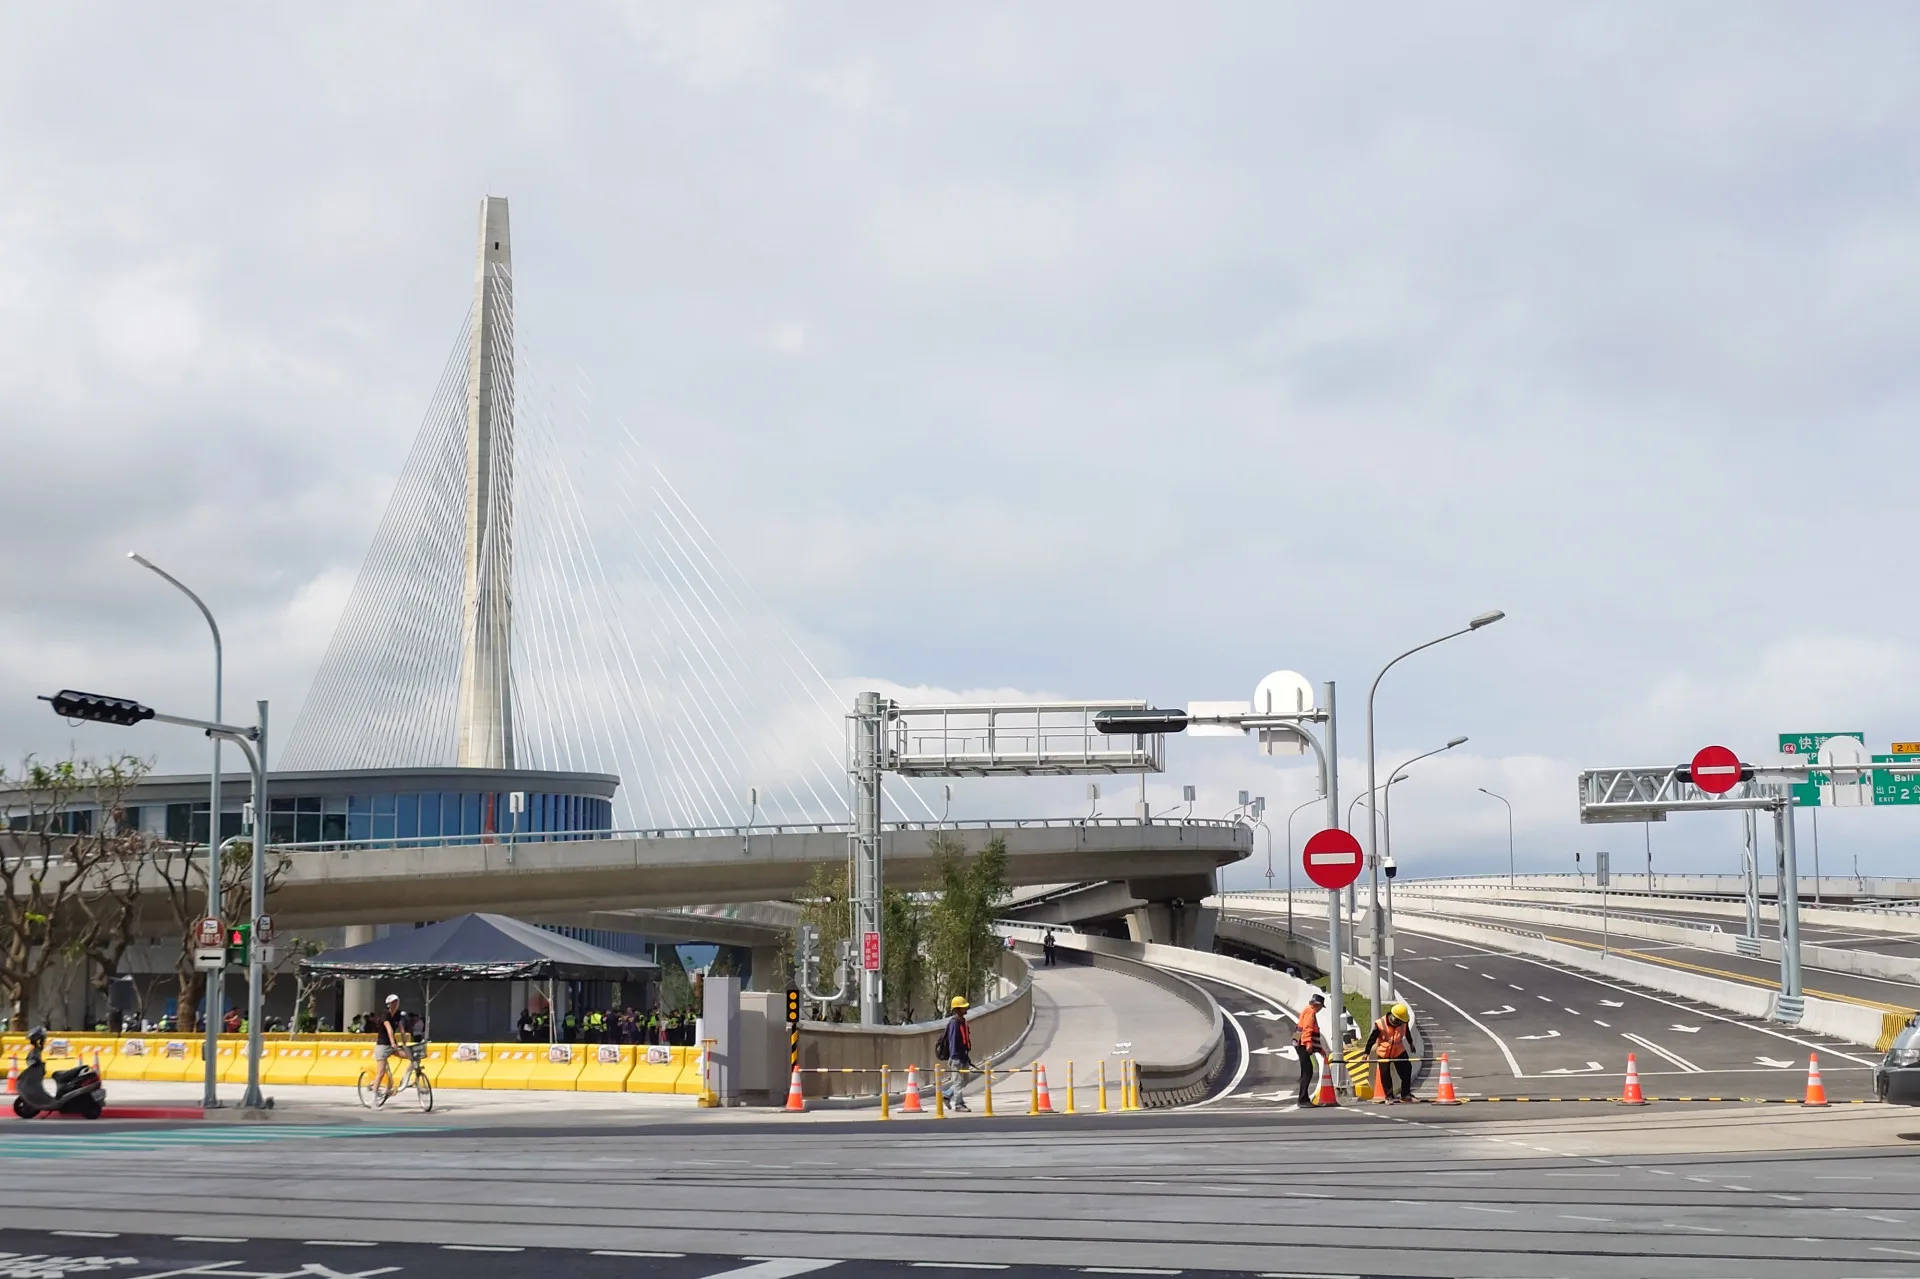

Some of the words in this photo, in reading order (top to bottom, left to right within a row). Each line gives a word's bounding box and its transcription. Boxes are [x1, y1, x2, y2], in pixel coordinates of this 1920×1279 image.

[1785, 744, 1794, 752] 64
[1894, 774, 1914, 782] Bali
[1875, 785, 1897, 795] 出口
[1900, 788, 1910, 800] 2
